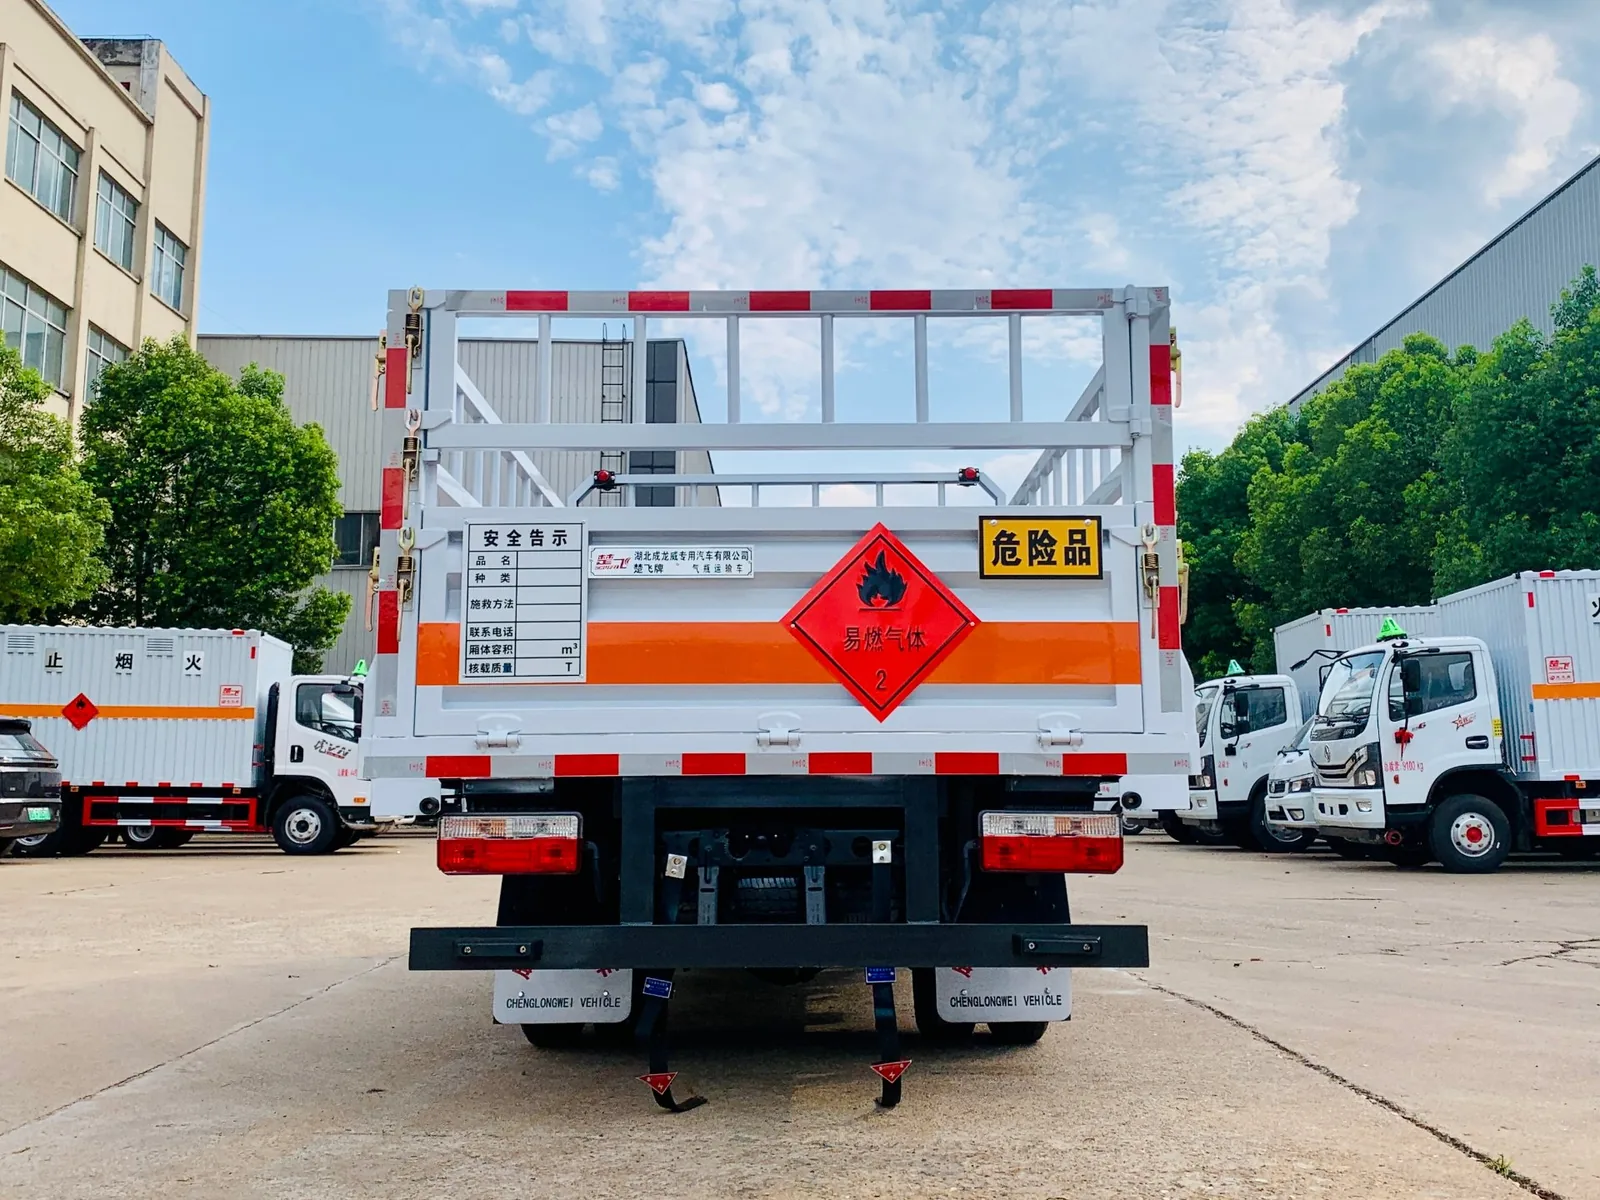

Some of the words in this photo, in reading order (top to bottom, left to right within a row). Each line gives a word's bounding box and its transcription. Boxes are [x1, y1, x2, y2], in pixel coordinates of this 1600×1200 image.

[483, 529, 568, 548] 安全告示
[991, 529, 1092, 567] 危险品
[633, 550, 750, 562] 湖北成龙威专用汽车有限公司
[633, 563, 664, 574] 楚飞牌
[470, 598, 514, 610] 施救方法
[469, 626, 514, 638] 联系电话
[843, 626, 926, 652] 易燃气体
[469, 644, 513, 655] 厢体容积
[468, 662, 513, 674] 核载质量
[565, 662, 573, 673] T
[875, 669, 888, 691] 2
[506, 997, 574, 1009] CHENGLONGWEI
[580, 997, 621, 1008] VEHICLE
[949, 995, 1018, 1008] CHENGLONGWEI
[1023, 994, 1063, 1006] VEHICLE
